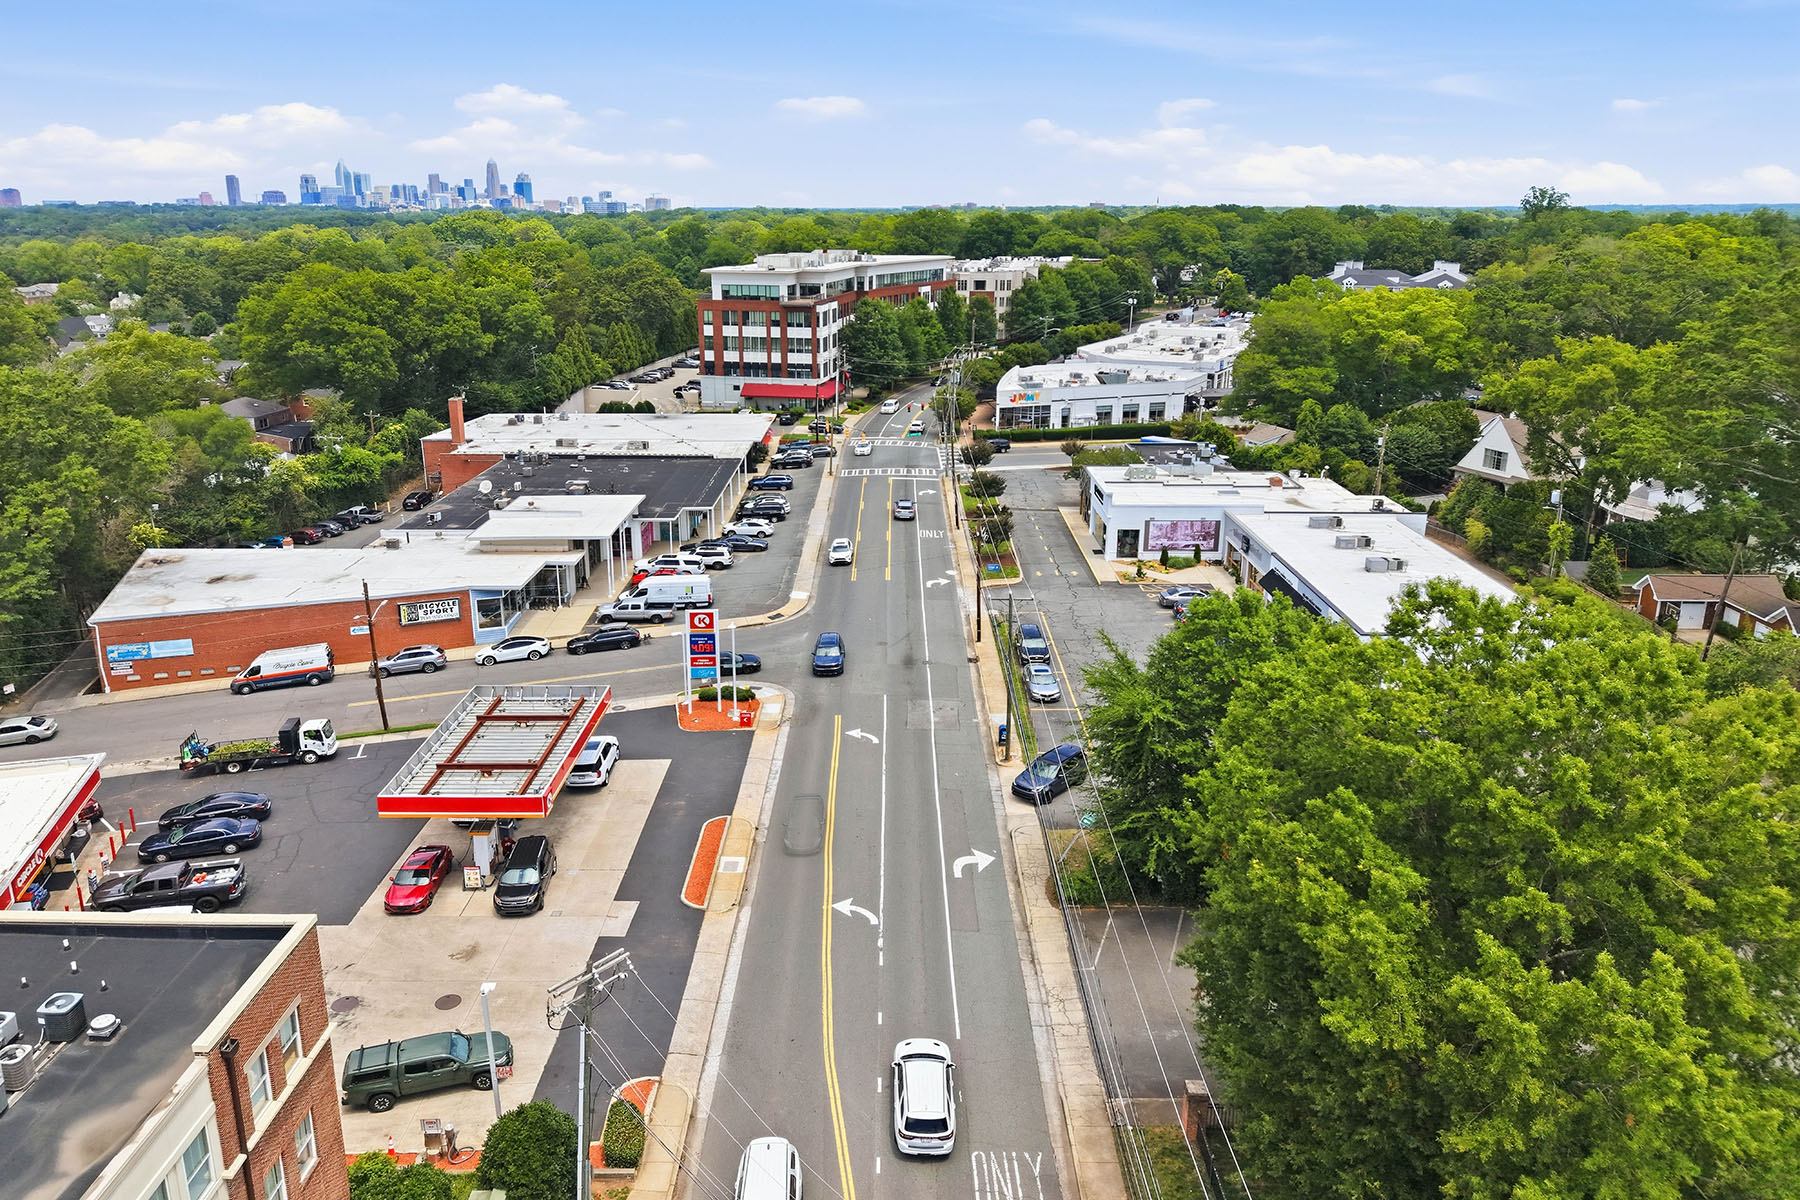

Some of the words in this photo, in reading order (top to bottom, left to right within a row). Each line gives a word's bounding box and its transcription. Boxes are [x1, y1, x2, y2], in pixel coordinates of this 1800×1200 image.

[1009, 392, 1041, 405] JIMMY
[920, 529, 944, 538] ONLY
[418, 600, 457, 610] BICYCLE
[423, 606, 454, 616] SPORT
[971, 1151, 1044, 1200] ONLY
